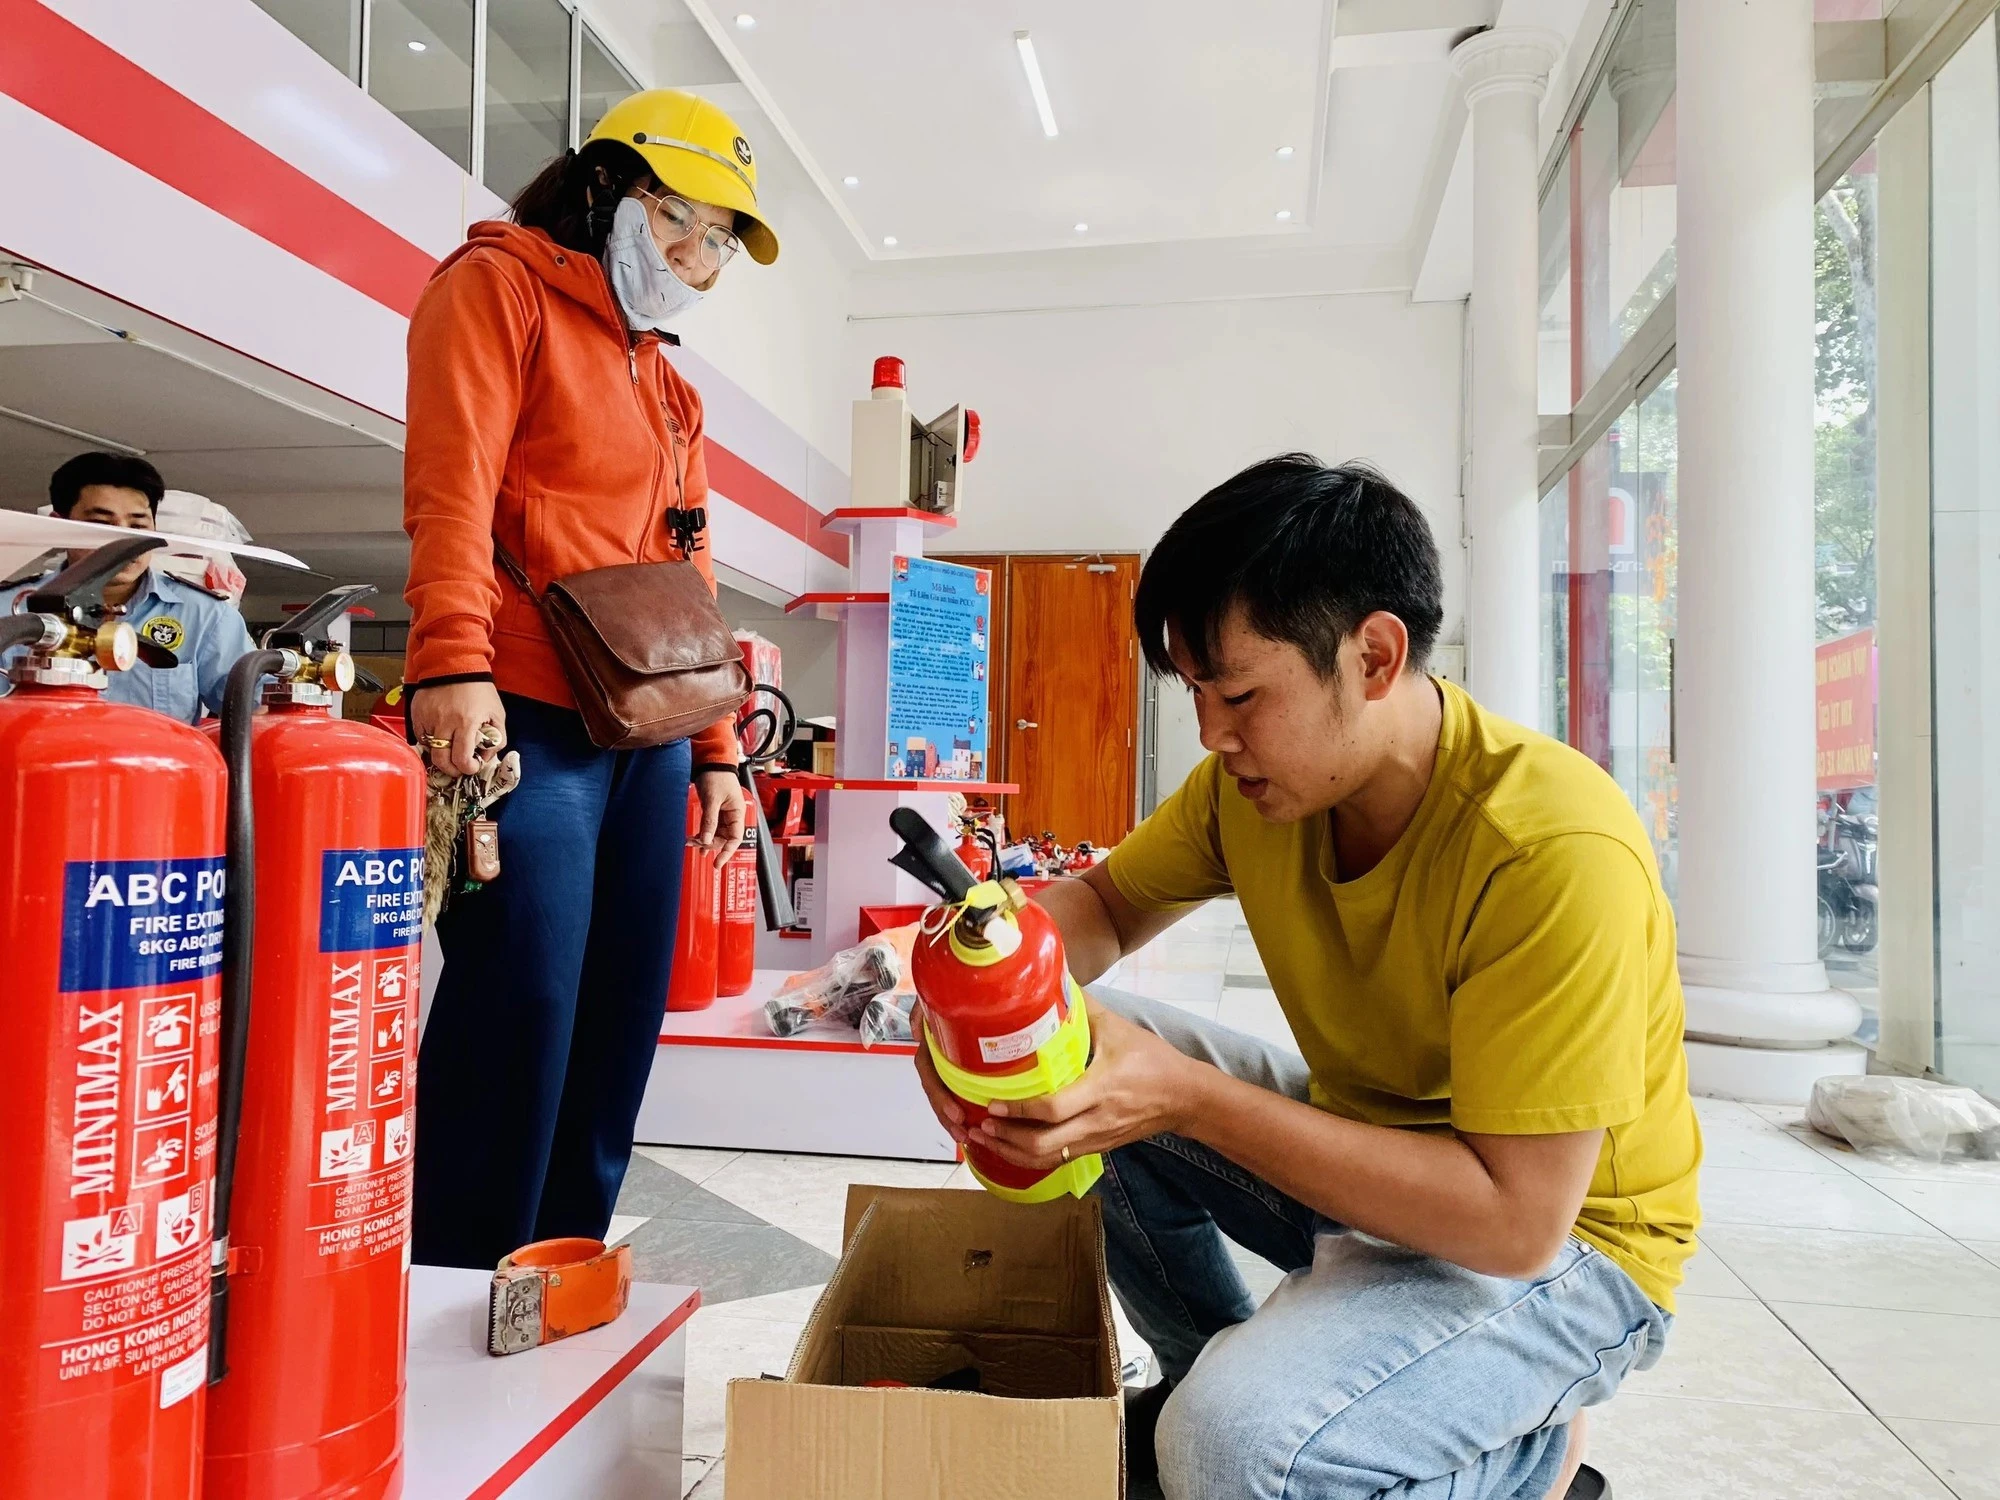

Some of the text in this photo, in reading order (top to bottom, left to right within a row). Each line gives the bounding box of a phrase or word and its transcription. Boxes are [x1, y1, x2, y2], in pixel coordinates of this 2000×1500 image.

[335, 859, 404, 887] ABC
[84, 872, 188, 908] ABC
[366, 893, 401, 908] FIRE
[129, 915, 182, 935] FIRE
[372, 911, 398, 925] 8KG
[399, 909, 415, 922] ABC
[393, 926, 410, 938] FIRE
[138, 938, 177, 955] 8KG
[179, 934, 207, 951] ABC
[170, 957, 197, 971] FIRE
[326, 960, 362, 1115] MINIMAX
[70, 1001, 124, 1199] MINIMAX
[334, 1207, 350, 1219] DO
[352, 1201, 371, 1216] NOT
[374, 1196, 389, 1209] USE
[335, 1191, 374, 1208] SECTON
[375, 1187, 386, 1199] OF
[319, 1225, 361, 1245] HONG
[363, 1214, 394, 1236] KONG
[318, 1243, 339, 1257] UNIT
[83, 1290, 140, 1317] SECTON
[142, 1286, 158, 1302] OF
[163, 1270, 194, 1294] GAUGE
[82, 1316, 105, 1331] DO
[107, 1307, 136, 1325] NOT
[141, 1299, 164, 1315] USE
[61, 1338, 120, 1365] HONG
[124, 1320, 170, 1349] KONG
[59, 1362, 90, 1381] UNIT
[124, 1348, 143, 1364] SIU
[145, 1341, 163, 1357] WAI
[133, 1362, 150, 1376] LAI
[151, 1352, 168, 1369] CHI
